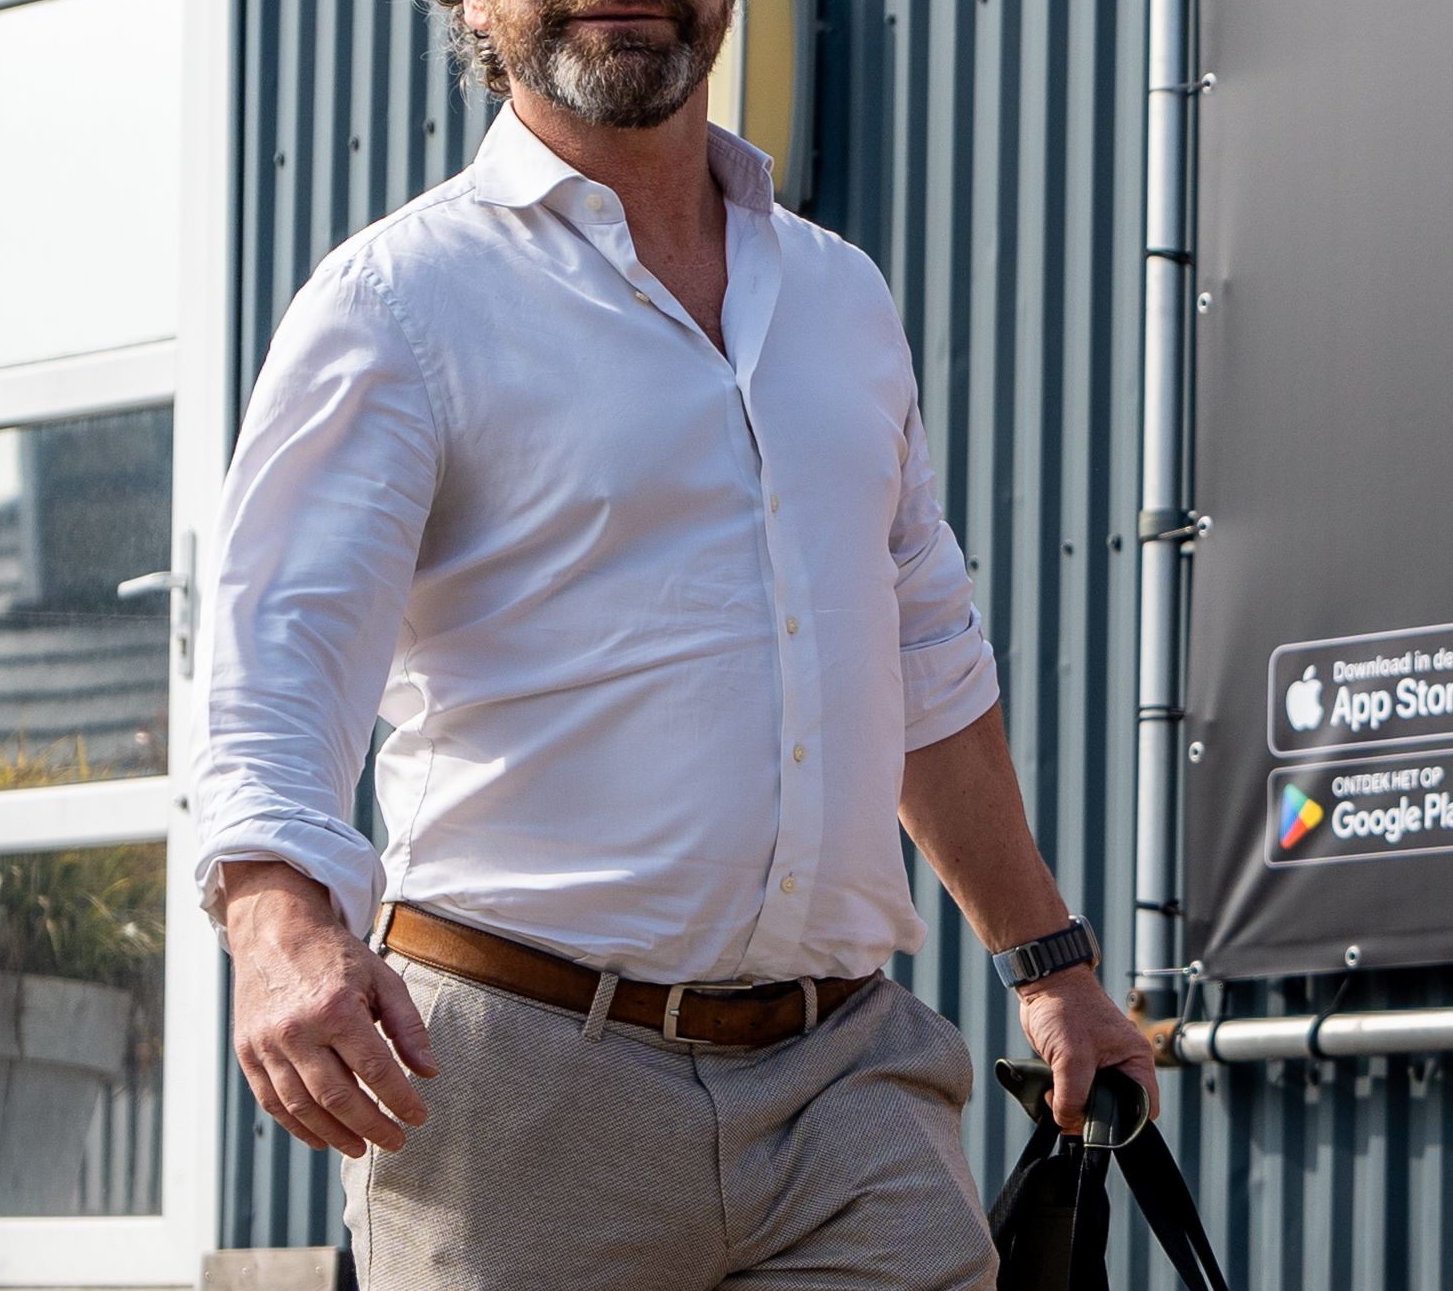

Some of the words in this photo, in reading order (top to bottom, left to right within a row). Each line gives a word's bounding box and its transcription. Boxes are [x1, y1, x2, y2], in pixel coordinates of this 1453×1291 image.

[1332, 651, 1413, 684] Download
[1413, 649, 1432, 672] in
[1330, 685, 1393, 733] App
[1331, 773, 1392, 799] ONTDEK
[1391, 768, 1420, 791] HET
[1419, 765, 1445, 789] OP
[1331, 800, 1424, 844] Google
